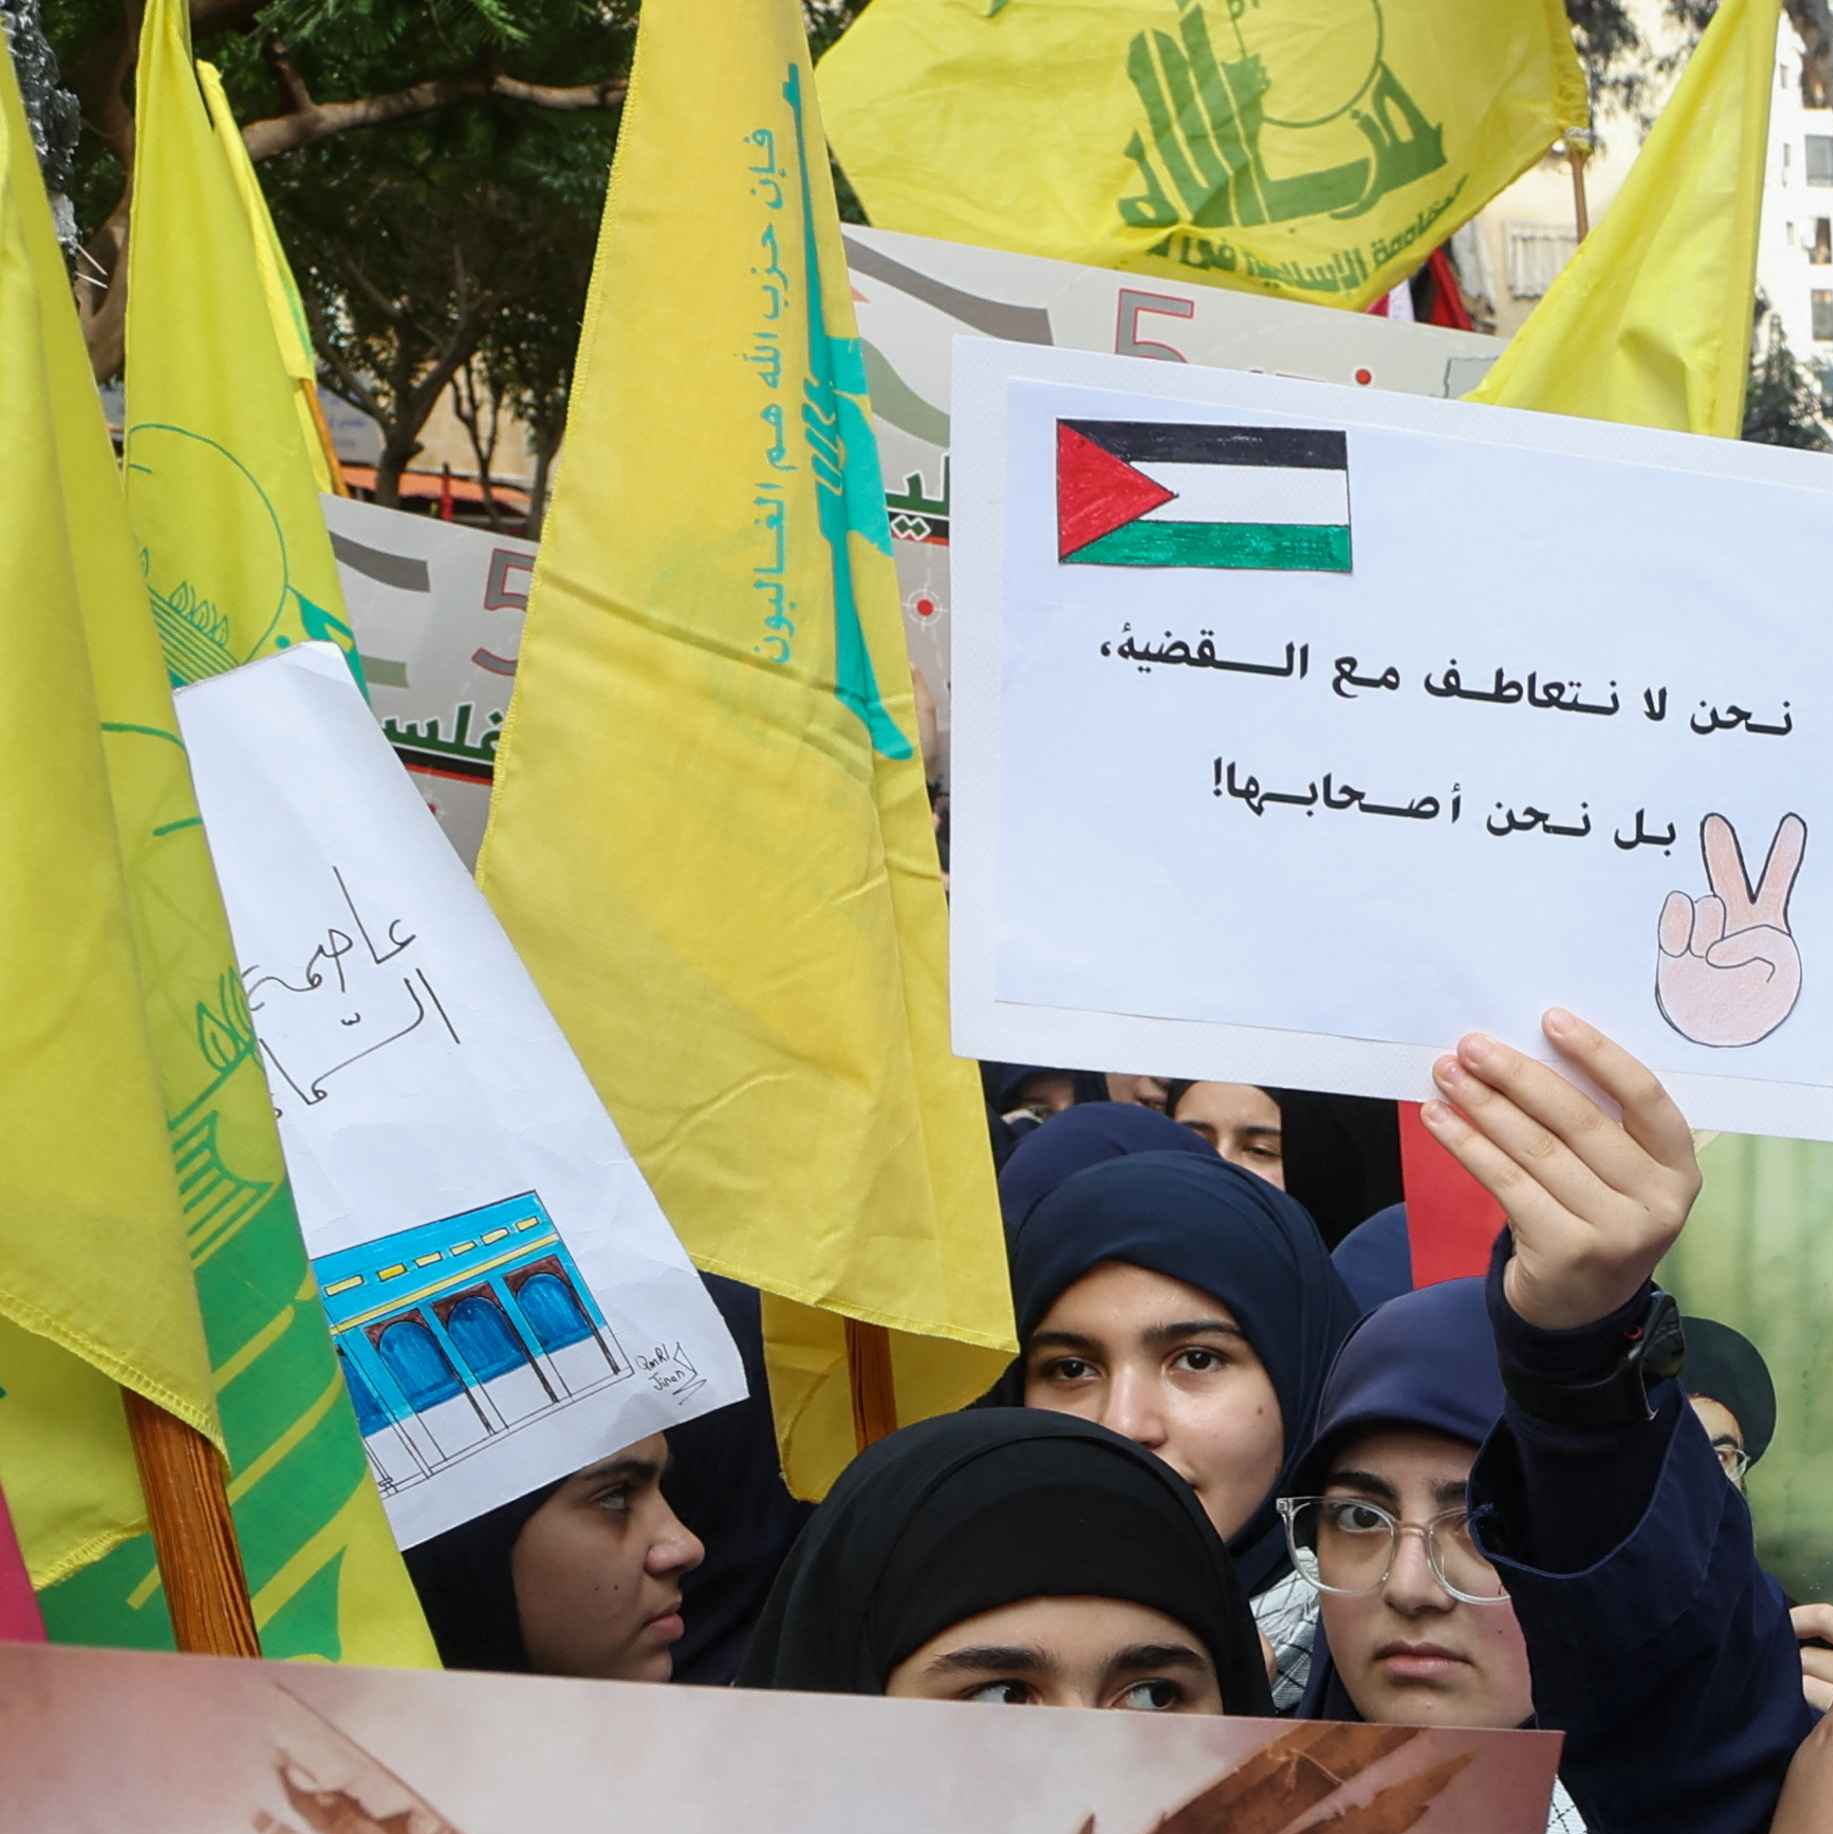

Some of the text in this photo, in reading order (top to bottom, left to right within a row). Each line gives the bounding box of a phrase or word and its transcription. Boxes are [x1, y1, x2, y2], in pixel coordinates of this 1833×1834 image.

[750, 222, 789, 321] حزب
[760, 403, 798, 472] هم
[752, 482, 798, 665] الغالبون
[1331, 655, 1401, 699] مع
[1423, 658, 1620, 716] نتعاطف
[1642, 685, 1668, 722] لا
[1690, 700, 1793, 737] نحن
[1212, 755, 1677, 857] بل نحن أصحابها!
